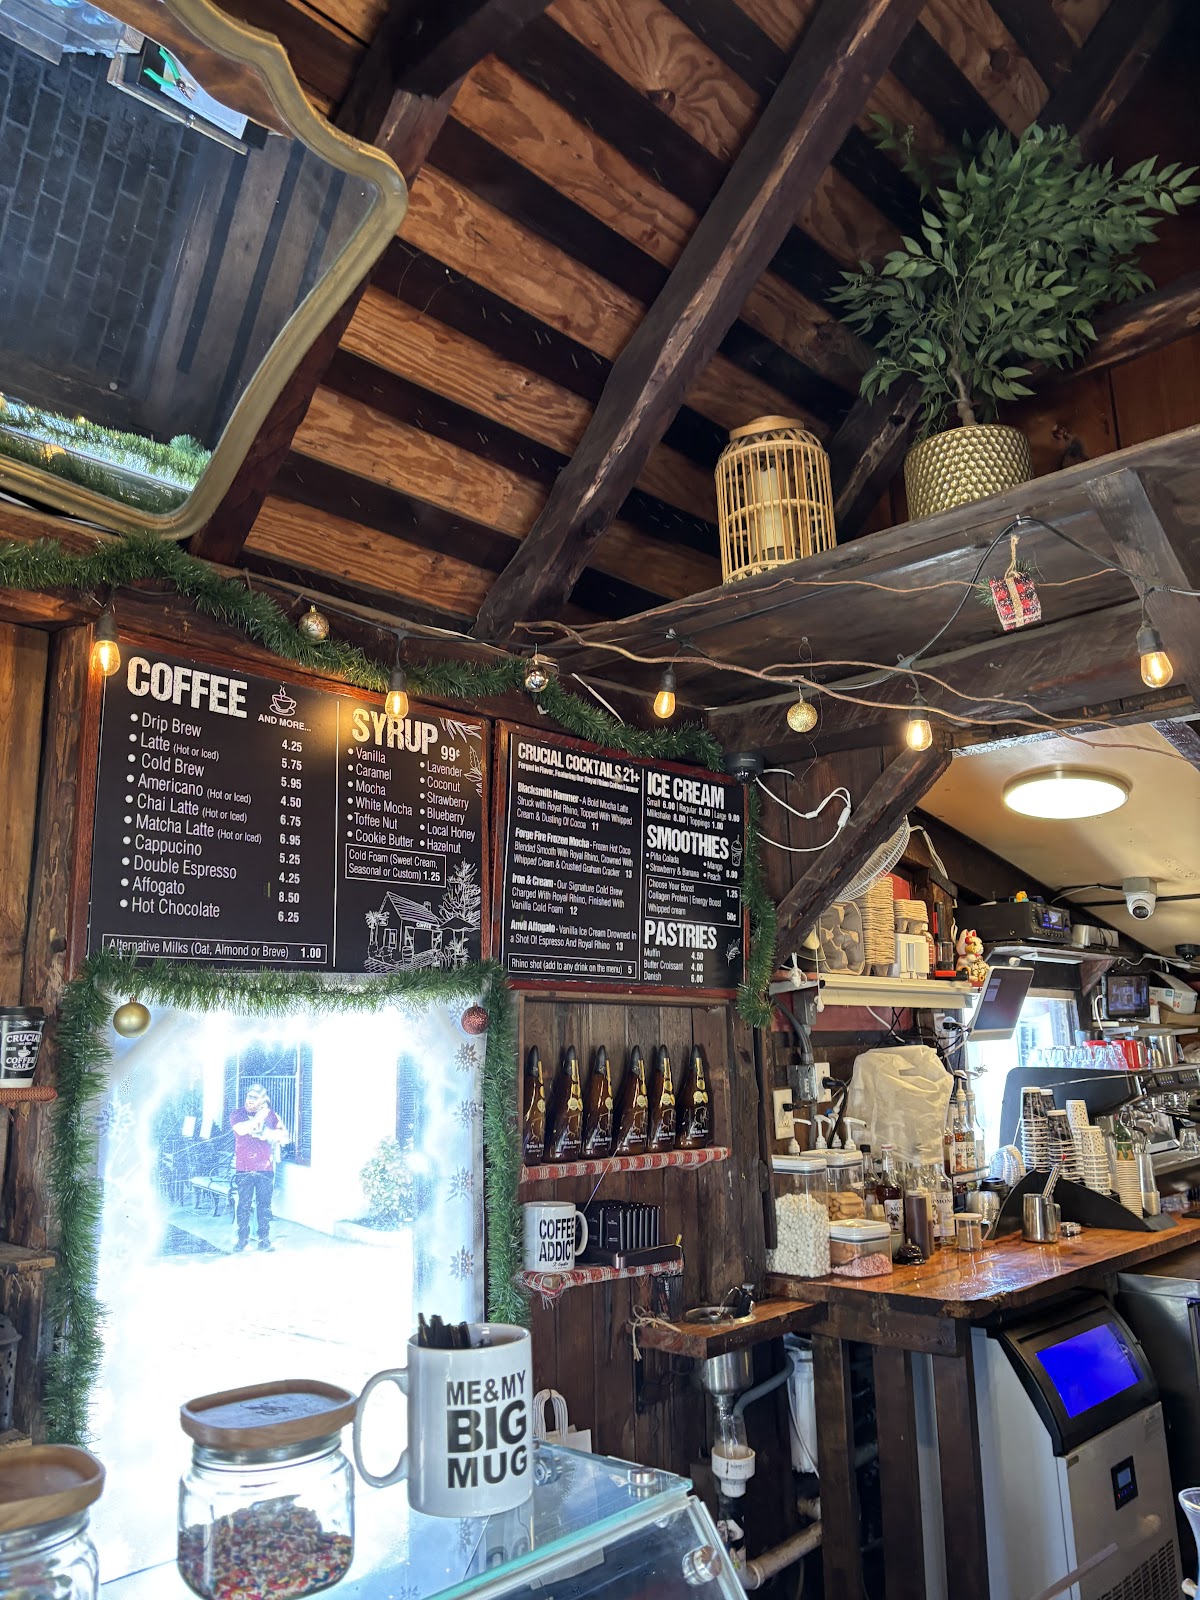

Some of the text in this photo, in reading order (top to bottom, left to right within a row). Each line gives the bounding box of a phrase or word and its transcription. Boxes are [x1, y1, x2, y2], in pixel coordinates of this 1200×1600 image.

[127, 656, 247, 718] COFFEE
[142, 713, 202, 738] Drip Brew
[258, 714, 311, 731] AND MORE...
[352, 708, 460, 761] SYRUP 99¢
[141, 732, 219, 762] Latte (Hot or Iced)
[282, 740, 302, 752] 4.25
[356, 747, 386, 763] Vanilla
[141, 753, 204, 777] Cold Brew
[281, 758, 302, 771] 5.75
[428, 761, 462, 778] Lavender
[518, 742, 640, 783] CRUCIAL COCKTAILS 21+
[356, 763, 392, 781] Caramel
[138, 773, 251, 805] Americano (Hot or Iced)
[281, 777, 302, 789] 5.95
[355, 780, 386, 795] Mocha
[427, 776, 460, 792] Coconut
[647, 771, 724, 809] ICE CREAM
[427, 792, 469, 810] Strawberry
[518, 782, 579, 803] Blacksmith Hammer
[137, 793, 247, 823] Chai Latte (Hot or Iced)
[280, 796, 302, 808] 4.50
[355, 797, 412, 816] White Mocha
[647, 797, 660, 807] Small
[663, 801, 675, 810] 6.00
[679, 803, 697, 814] Regular
[714, 810, 726, 821] Large
[280, 815, 301, 827] 6.75
[354, 813, 398, 830] Toffee Nut
[427, 808, 465, 825] Blueberry
[647, 808, 671, 820] Milkshake
[690, 816, 710, 829] Toppings
[712, 821, 723, 830] 1.00
[136, 814, 262, 844] Matcha Latte (Hot or Iced)
[427, 824, 475, 842] Local Honey
[135, 834, 202, 856] Cappucino
[280, 833, 301, 845] 6.95
[355, 829, 414, 848] Cookie Butter
[427, 839, 461, 854] Hazelnut
[647, 824, 729, 860] SMOOTHIES
[134, 855, 237, 880] Double Espresso
[279, 853, 300, 865] 5.25
[349, 849, 438, 869] Cold Foam (Sweet Cream,
[662, 853, 679, 864] Colada
[707, 861, 723, 871] Mango
[279, 871, 300, 884] 4.25
[349, 863, 440, 881] Seasonal or Custom) 1.25
[650, 863, 699, 878] Strawberry & Banana
[707, 872, 721, 881] Peach
[132, 876, 185, 896] Affogato
[649, 879, 738, 898] Choose Your Boost 1.25
[279, 892, 300, 904] 8.50
[649, 890, 721, 907] Collagen Protein Energy Boost
[131, 897, 220, 918] Hot Chocolate
[511, 900, 577, 915] Vanilla Cold Foam 12
[648, 903, 670, 914] Whipped
[671, 906, 686, 915] cream
[278, 911, 299, 923] 6.25
[516, 935, 529, 944] Shot
[530, 936, 538, 944] Of
[539, 936, 564, 947] Espresso
[565, 938, 576, 947] And
[578, 939, 593, 950] Royal
[594, 940, 610, 950] Rhino
[616, 942, 623, 951] 13
[645, 920, 717, 949] PASTRIES
[109, 938, 322, 959] Alternative Milks (Oat, Almond or Breve) 1.00
[644, 948, 703, 960] Muffin 4.50
[512, 958, 632, 975] Rhino shot (add to any drink on the menu) 5
[644, 959, 703, 971] Butter Croissant 4.00
[644, 972, 661, 980] Danish
[539, 1217, 574, 1239] COFFEE
[539, 1240, 574, 1261] ADDICT
[447, 1370, 526, 1406] ME&MY
[447, 1400, 527, 1453] BIG
[448, 1445, 527, 1488] MUG
